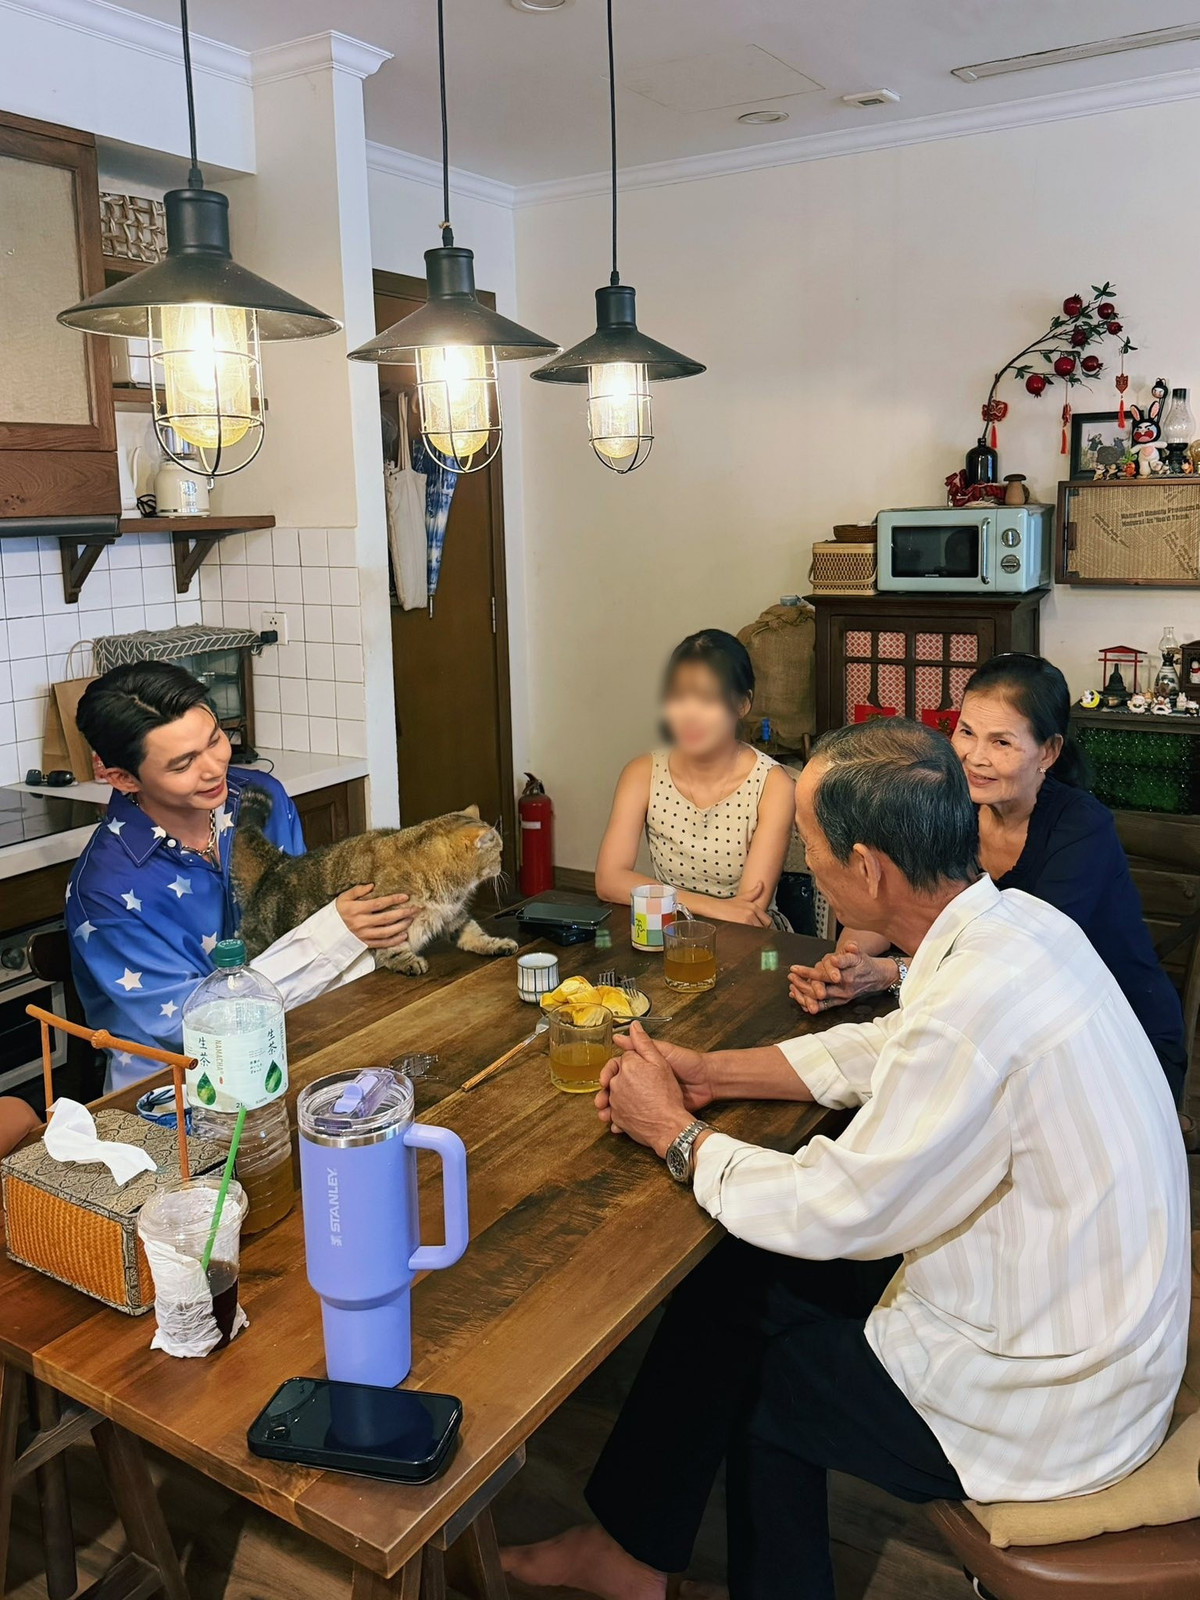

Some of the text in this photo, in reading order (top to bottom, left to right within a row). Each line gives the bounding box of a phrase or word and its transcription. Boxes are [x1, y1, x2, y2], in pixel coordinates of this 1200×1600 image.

[1121, 511, 1144, 519] Natural
[1122, 519, 1144, 527] Natural
[199, 1036, 211, 1067] 生茶
[215, 1040, 224, 1071] NAMACHA
[327, 1167, 340, 1233] STANLEY
